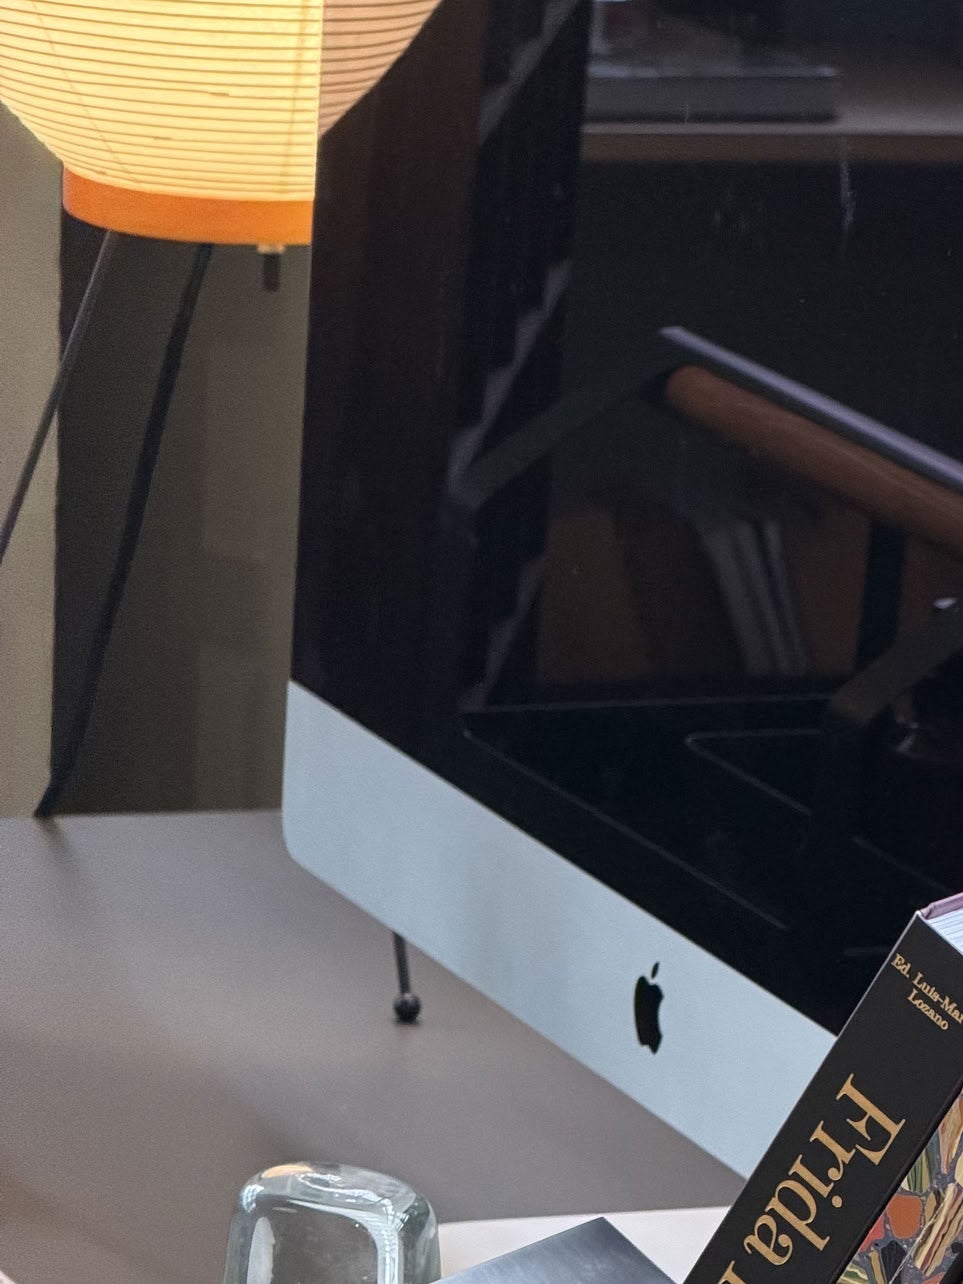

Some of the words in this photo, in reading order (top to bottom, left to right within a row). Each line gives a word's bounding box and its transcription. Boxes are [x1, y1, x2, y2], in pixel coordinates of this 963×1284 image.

[890, 952, 912, 978] Ed.
[907, 988, 949, 1031] Lozano
[743, 1073, 906, 1267] Frida
